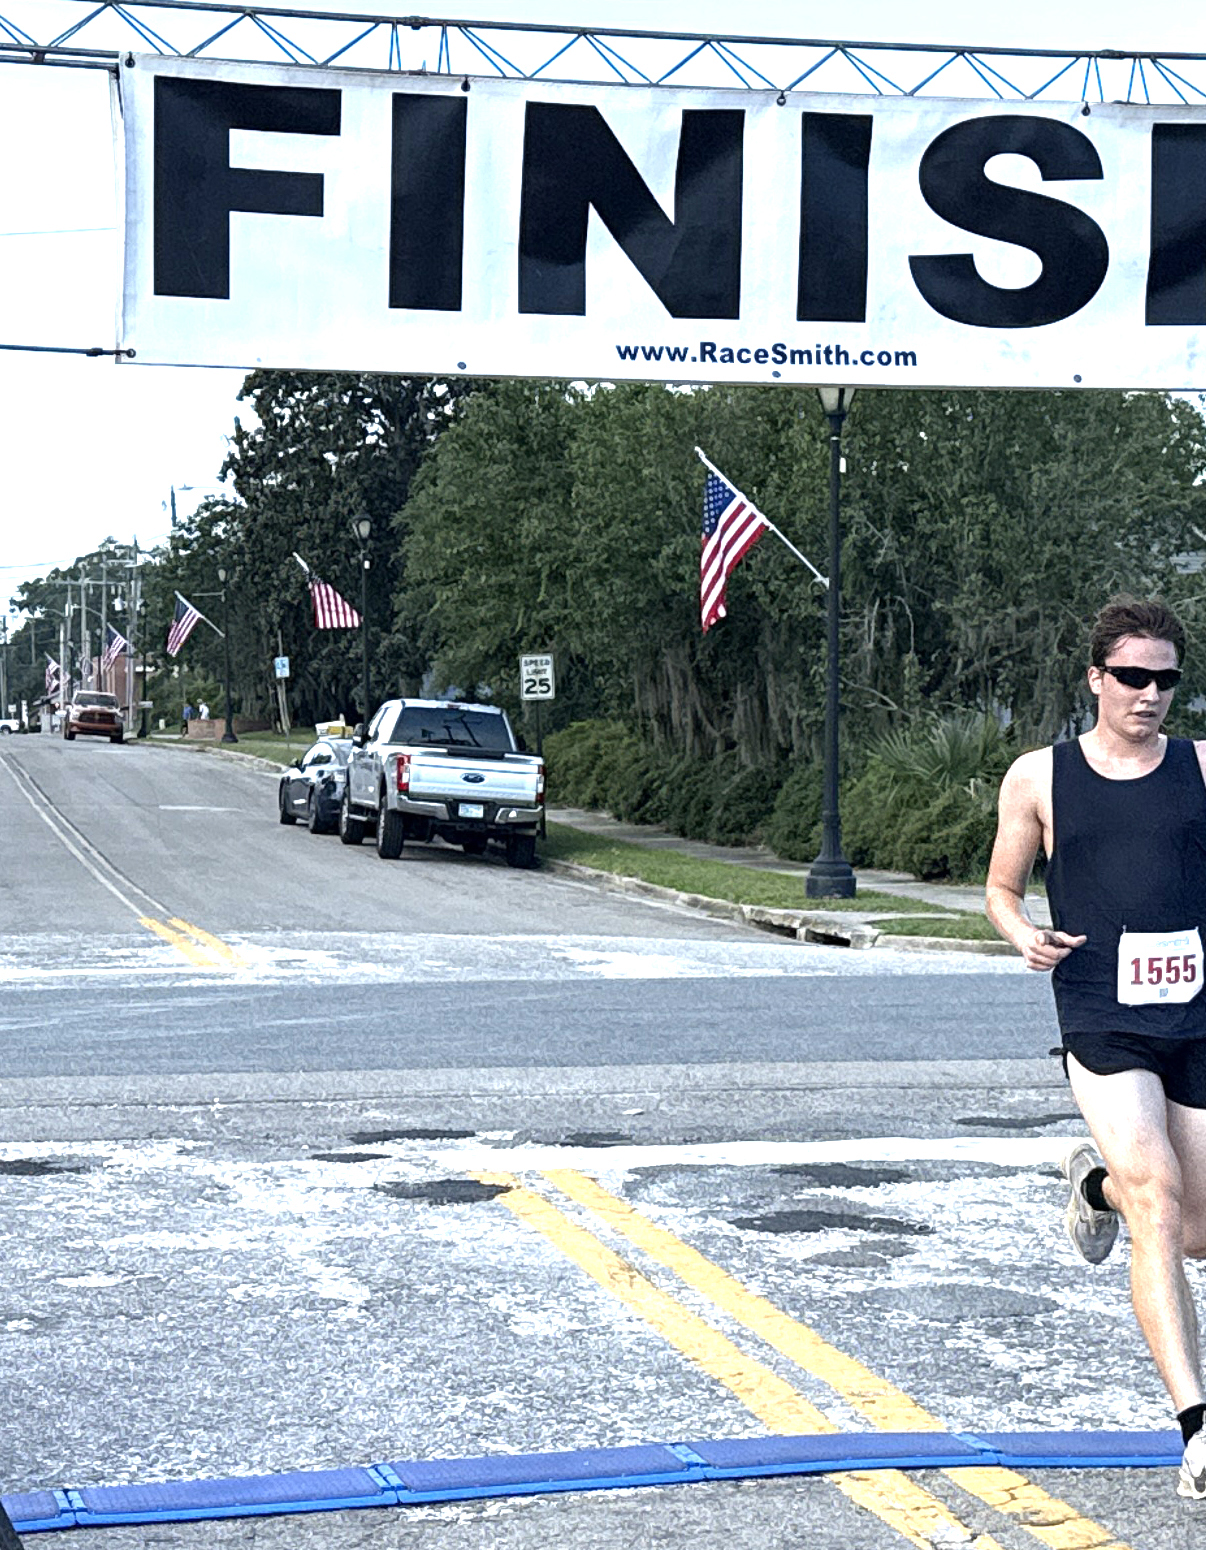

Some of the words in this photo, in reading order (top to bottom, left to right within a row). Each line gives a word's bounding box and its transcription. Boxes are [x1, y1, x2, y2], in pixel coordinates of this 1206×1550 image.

[615, 341, 918, 366] www.RaceSmith.com
[524, 677, 551, 695] 25
[1130, 953, 1197, 986] 1555
